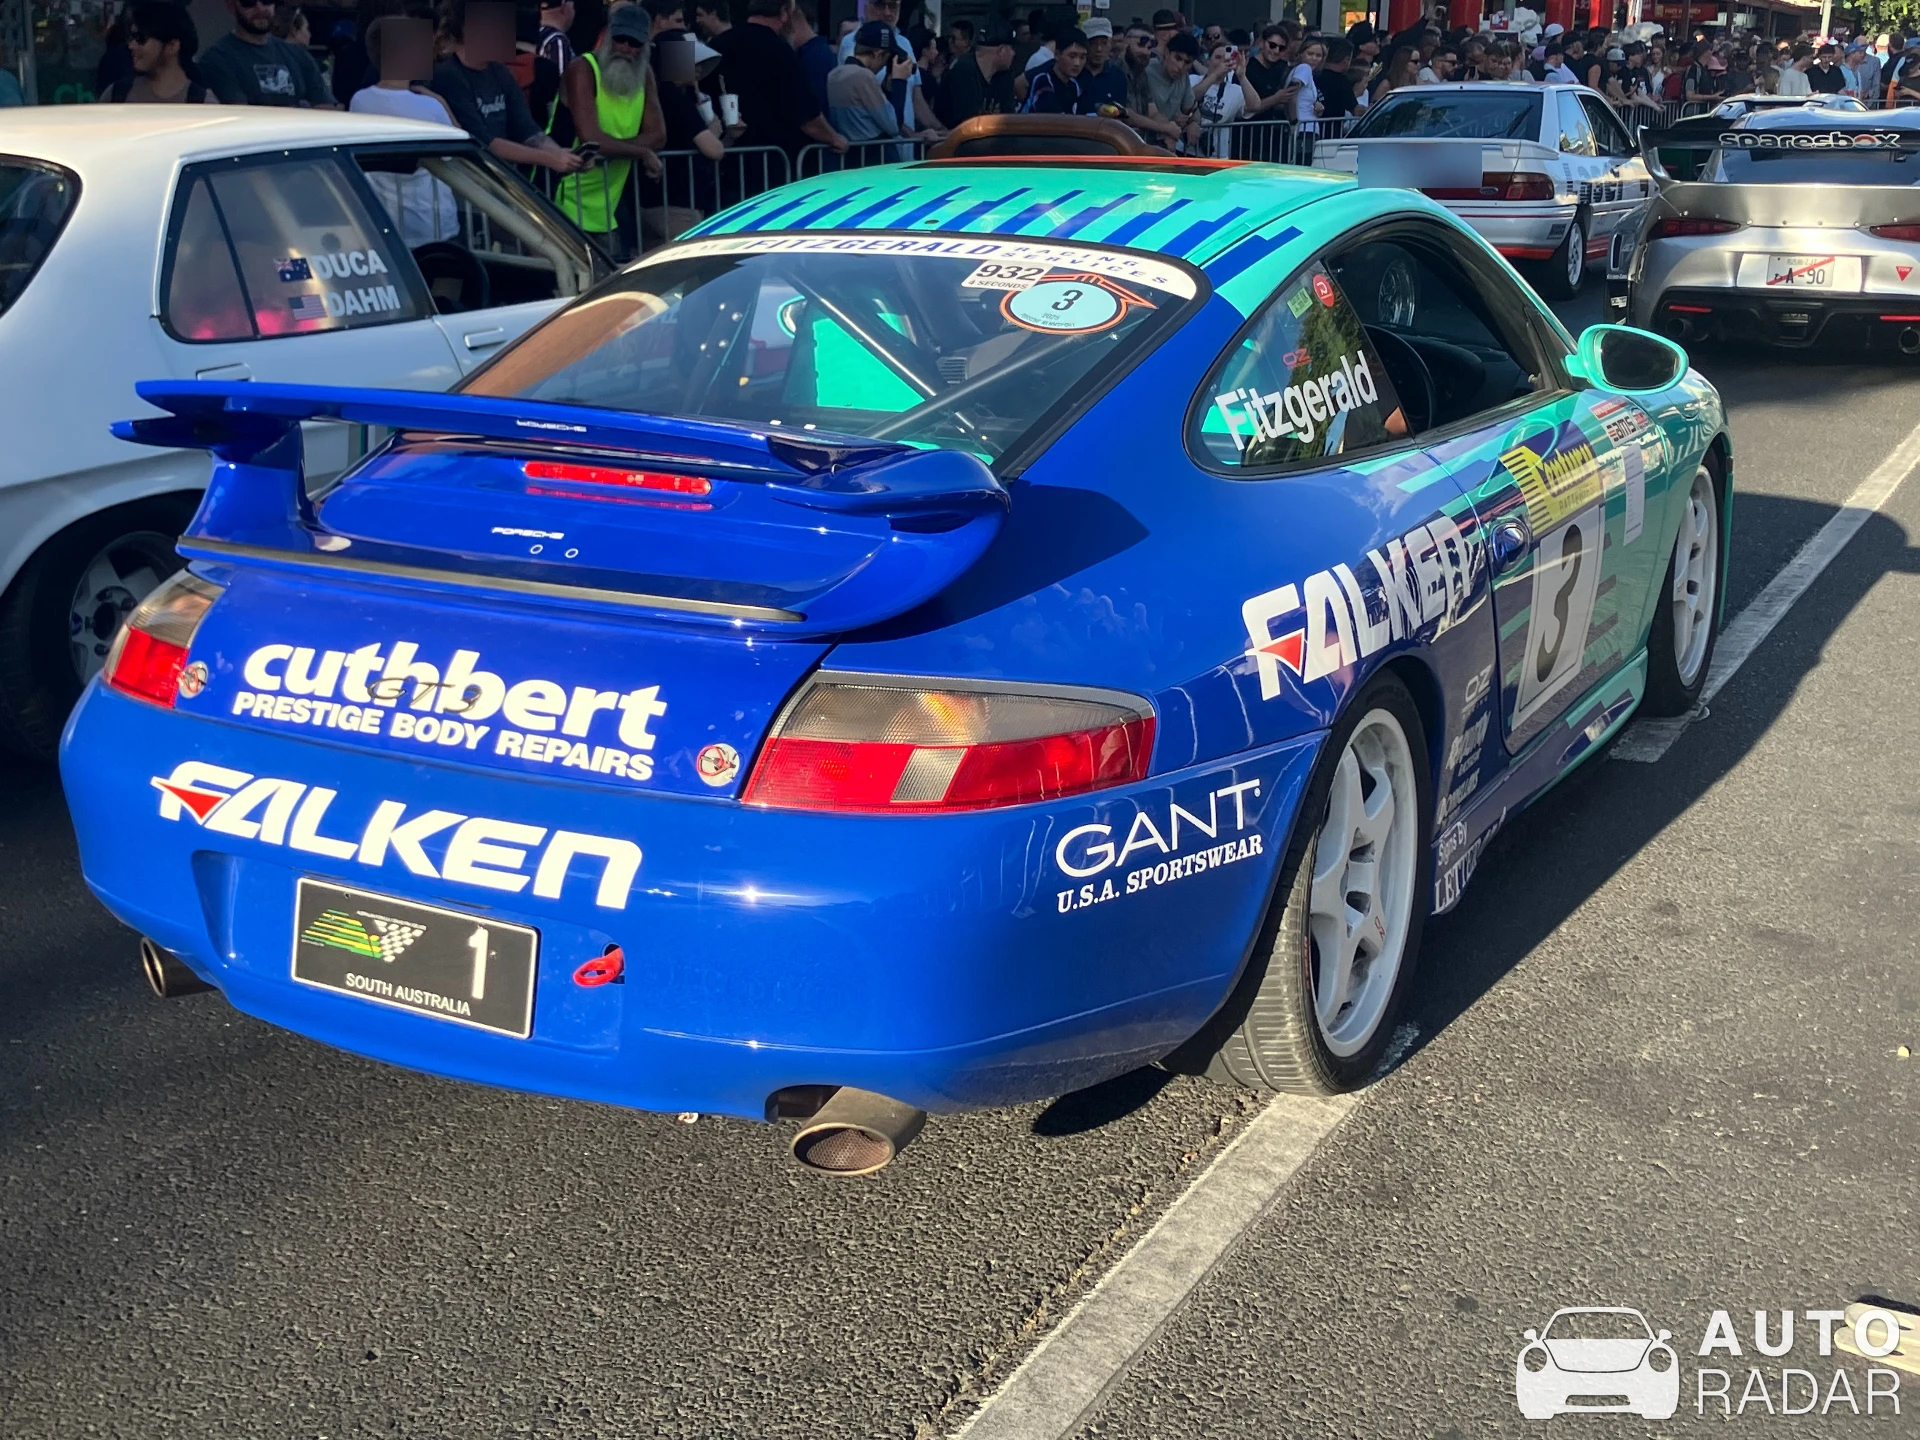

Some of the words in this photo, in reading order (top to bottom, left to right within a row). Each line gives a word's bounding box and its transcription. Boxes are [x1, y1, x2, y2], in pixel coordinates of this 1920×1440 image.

[1718, 131, 1901, 149] sparesbox
[311, 249, 388, 280] DUCA
[743, 238, 1003, 257] FITZGERALD
[1000, 251, 1169, 286] SERVICES
[1014, 246, 1140, 268] RACING
[976, 264, 1046, 282] 932
[326, 285, 402, 318] DAHM
[1051, 289, 1084, 311] 3
[1215, 350, 1379, 451] Fitzgerald
[1240, 515, 1471, 702] FALKEN
[1536, 523, 1583, 684] 3
[243, 640, 668, 751] cuthbert
[232, 691, 382, 735] PRESTIGE
[389, 710, 491, 751] BODY
[496, 729, 655, 781] REPAIRS
[150, 760, 644, 910] FALKEN
[1056, 877, 1121, 914] U.S.A.
[1125, 833, 1264, 895] SPORTSWEAR
[467, 923, 490, 1000] 1
[345, 972, 393, 998] SOUTH
[397, 985, 472, 1017] AUSTRALIA
